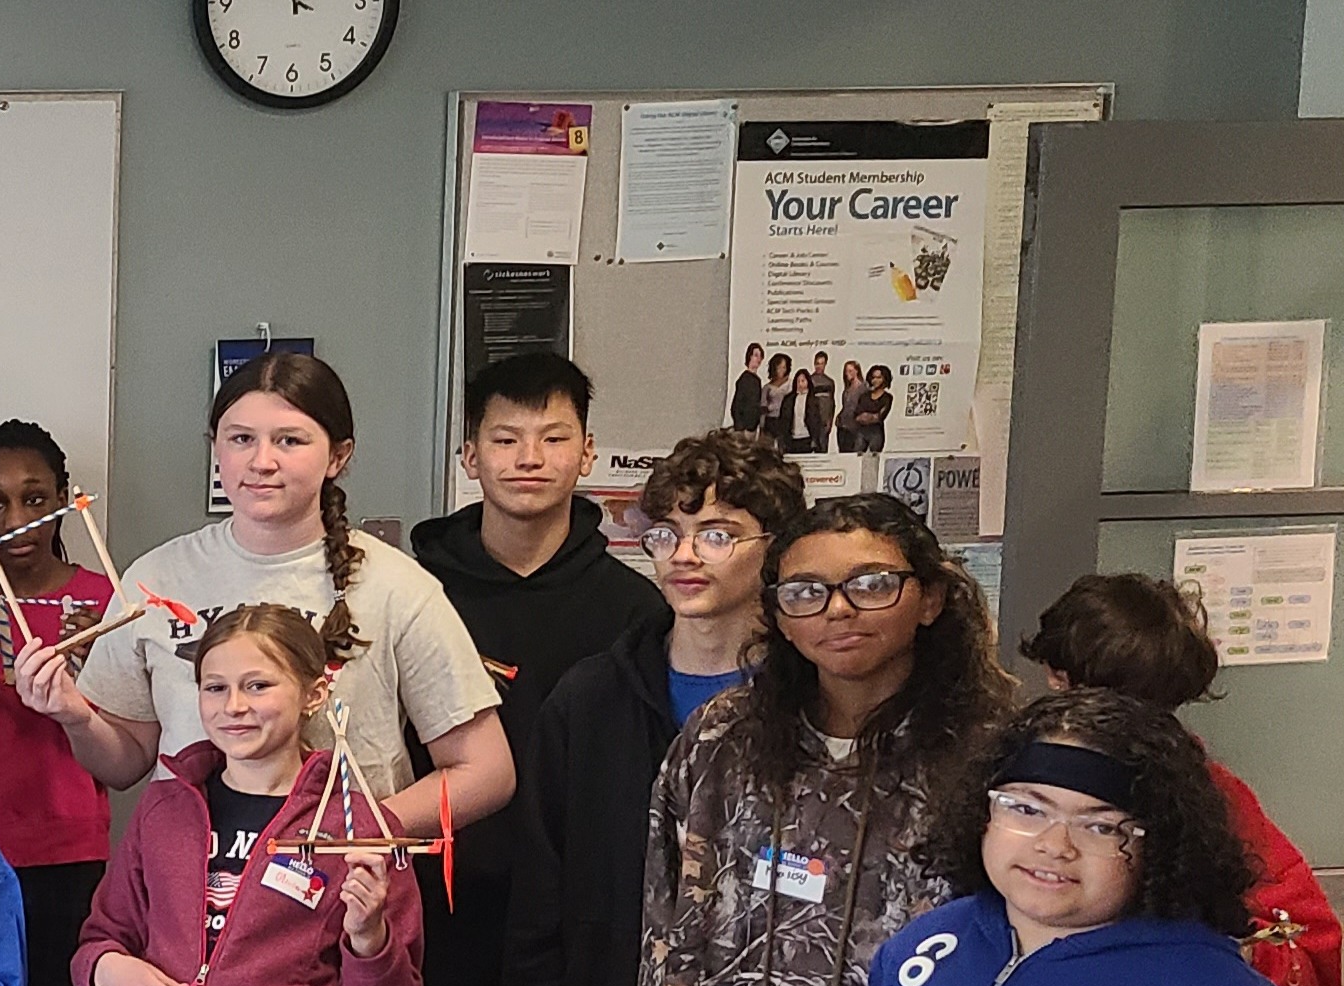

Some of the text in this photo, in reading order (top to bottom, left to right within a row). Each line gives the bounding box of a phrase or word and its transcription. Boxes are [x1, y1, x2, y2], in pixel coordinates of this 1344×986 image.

[228, 29, 241, 50] 8
[342, 25, 356, 45] 4
[257, 55, 268, 75] 7
[319, 52, 332, 72] 5
[285, 63, 299, 83] 6
[764, 170, 925, 186] ACM Student Membership
[765, 187, 959, 221] Your Career
[768, 223, 839, 236] Starts Here!
[610, 454, 655, 470] NaS
[289, 858, 314, 875] HELLO
